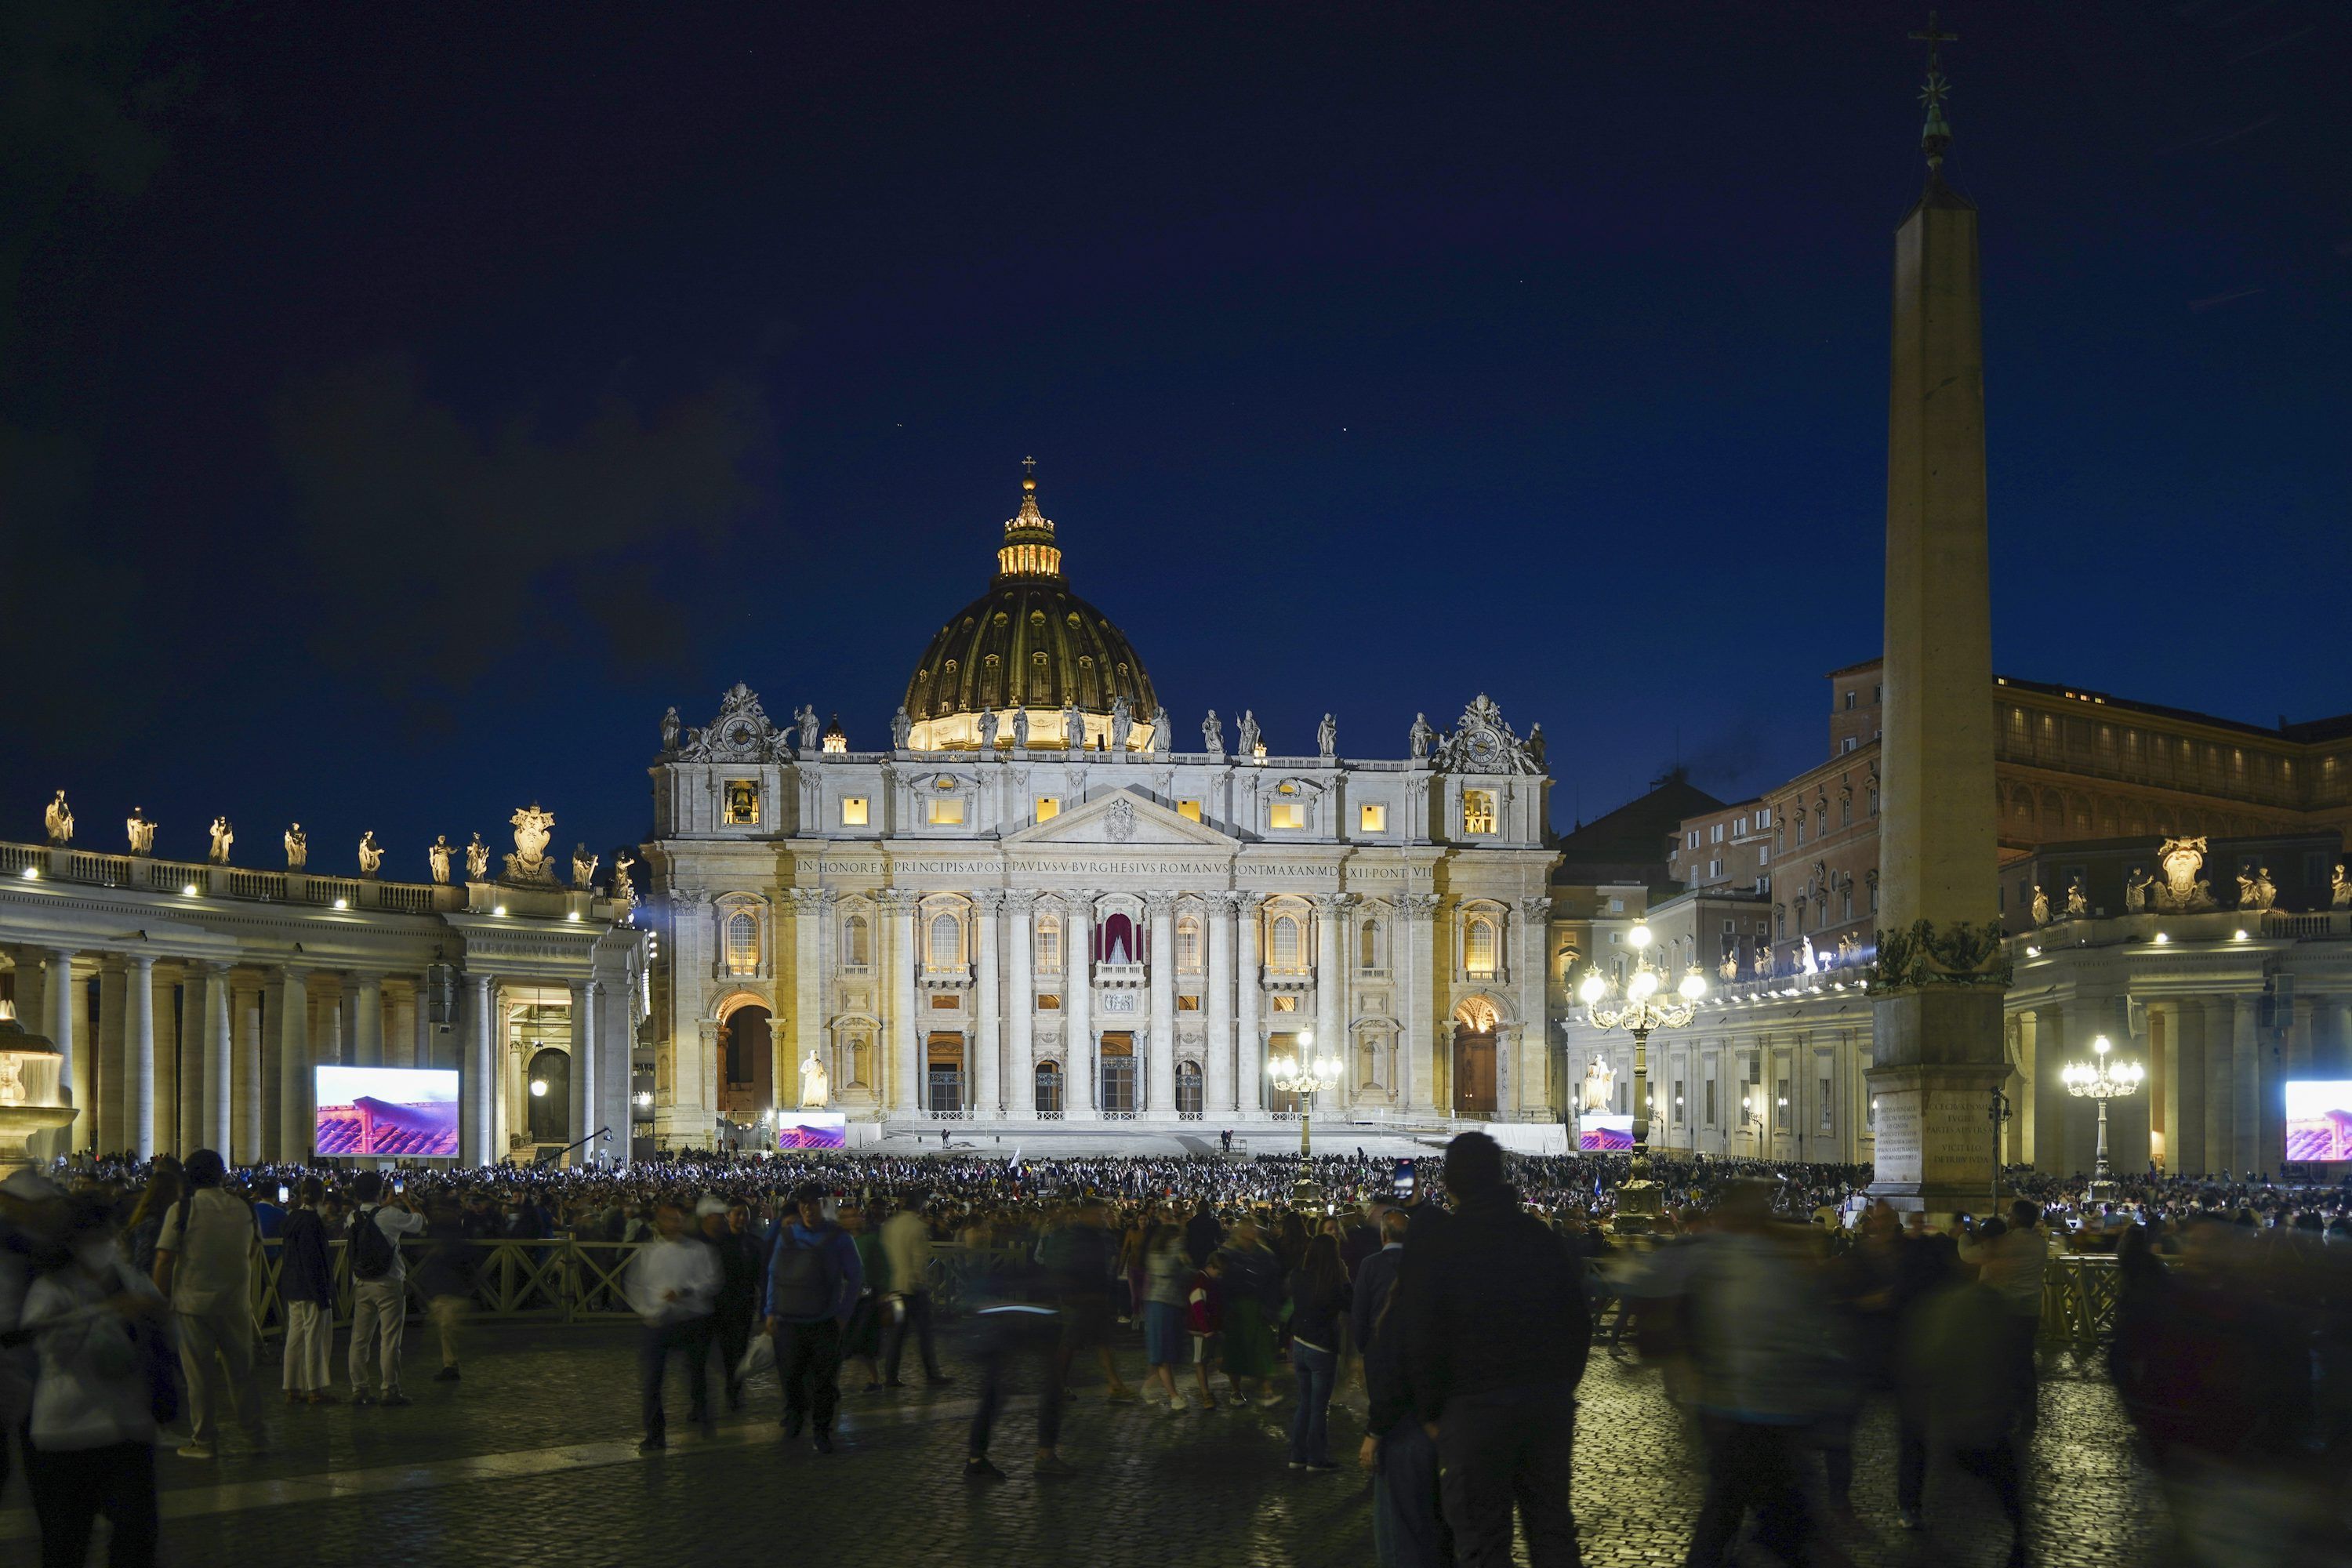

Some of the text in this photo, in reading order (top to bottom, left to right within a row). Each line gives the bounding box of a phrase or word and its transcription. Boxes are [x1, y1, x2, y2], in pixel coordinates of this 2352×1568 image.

[797, 860, 813, 871] IN
[818, 862, 890, 873] HONOREM
[894, 862, 964, 873] PRINCIPIS
[967, 862, 1009, 873] APOST
[1012, 861, 1058, 872] PAVLVS
[1072, 862, 1156, 873] BVRGHESIVS
[1160, 862, 1229, 873] ROMANVS
[1230, 865, 1265, 875] PONT
[1266, 866, 1294, 876] MAX
[1297, 866, 1315, 876] AN
[1318, 866, 1368, 877] MDCXII
[1372, 867, 1407, 878] PONT
[1414, 867, 1432, 877] VII
